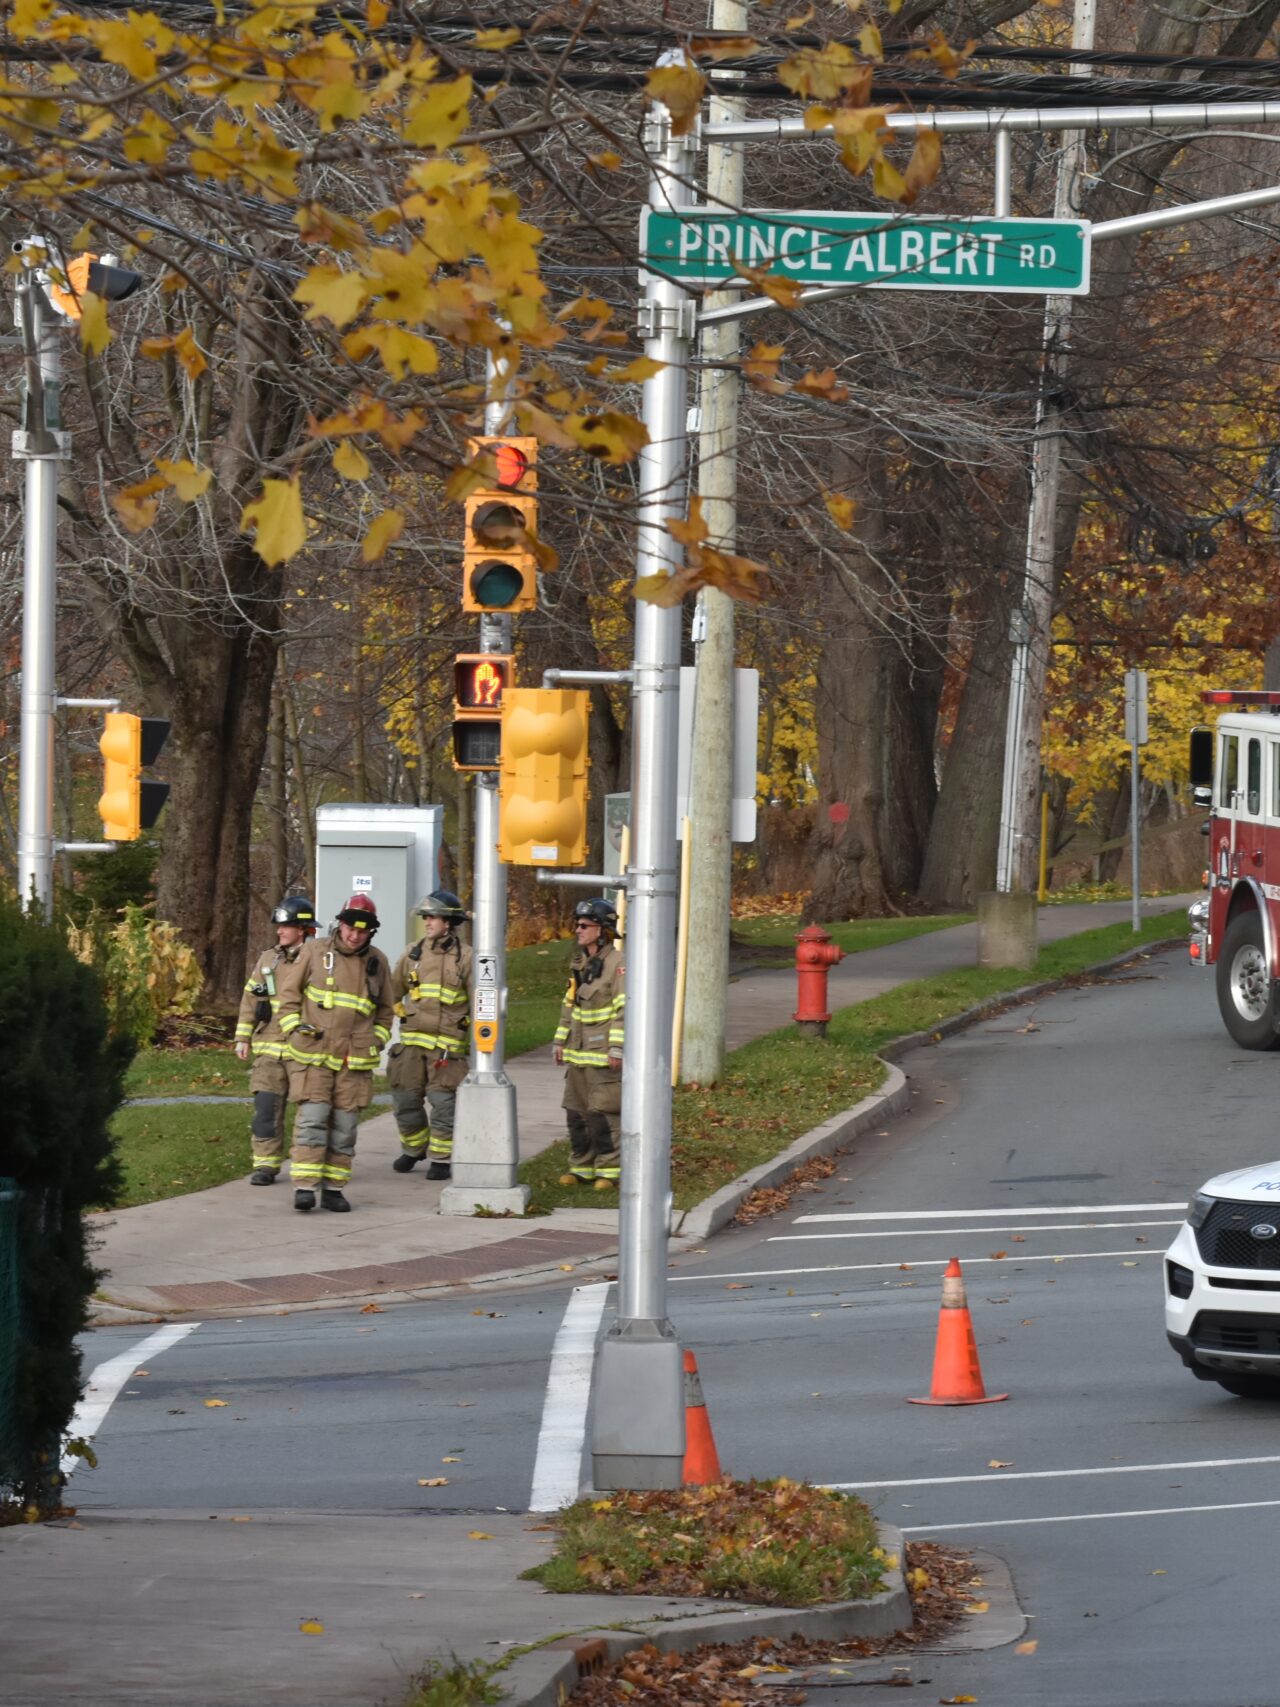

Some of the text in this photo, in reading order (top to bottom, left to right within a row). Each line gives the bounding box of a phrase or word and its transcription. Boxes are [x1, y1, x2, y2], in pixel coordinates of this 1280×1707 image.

[679, 222, 1056, 276] PRINCE ALBERT RD
